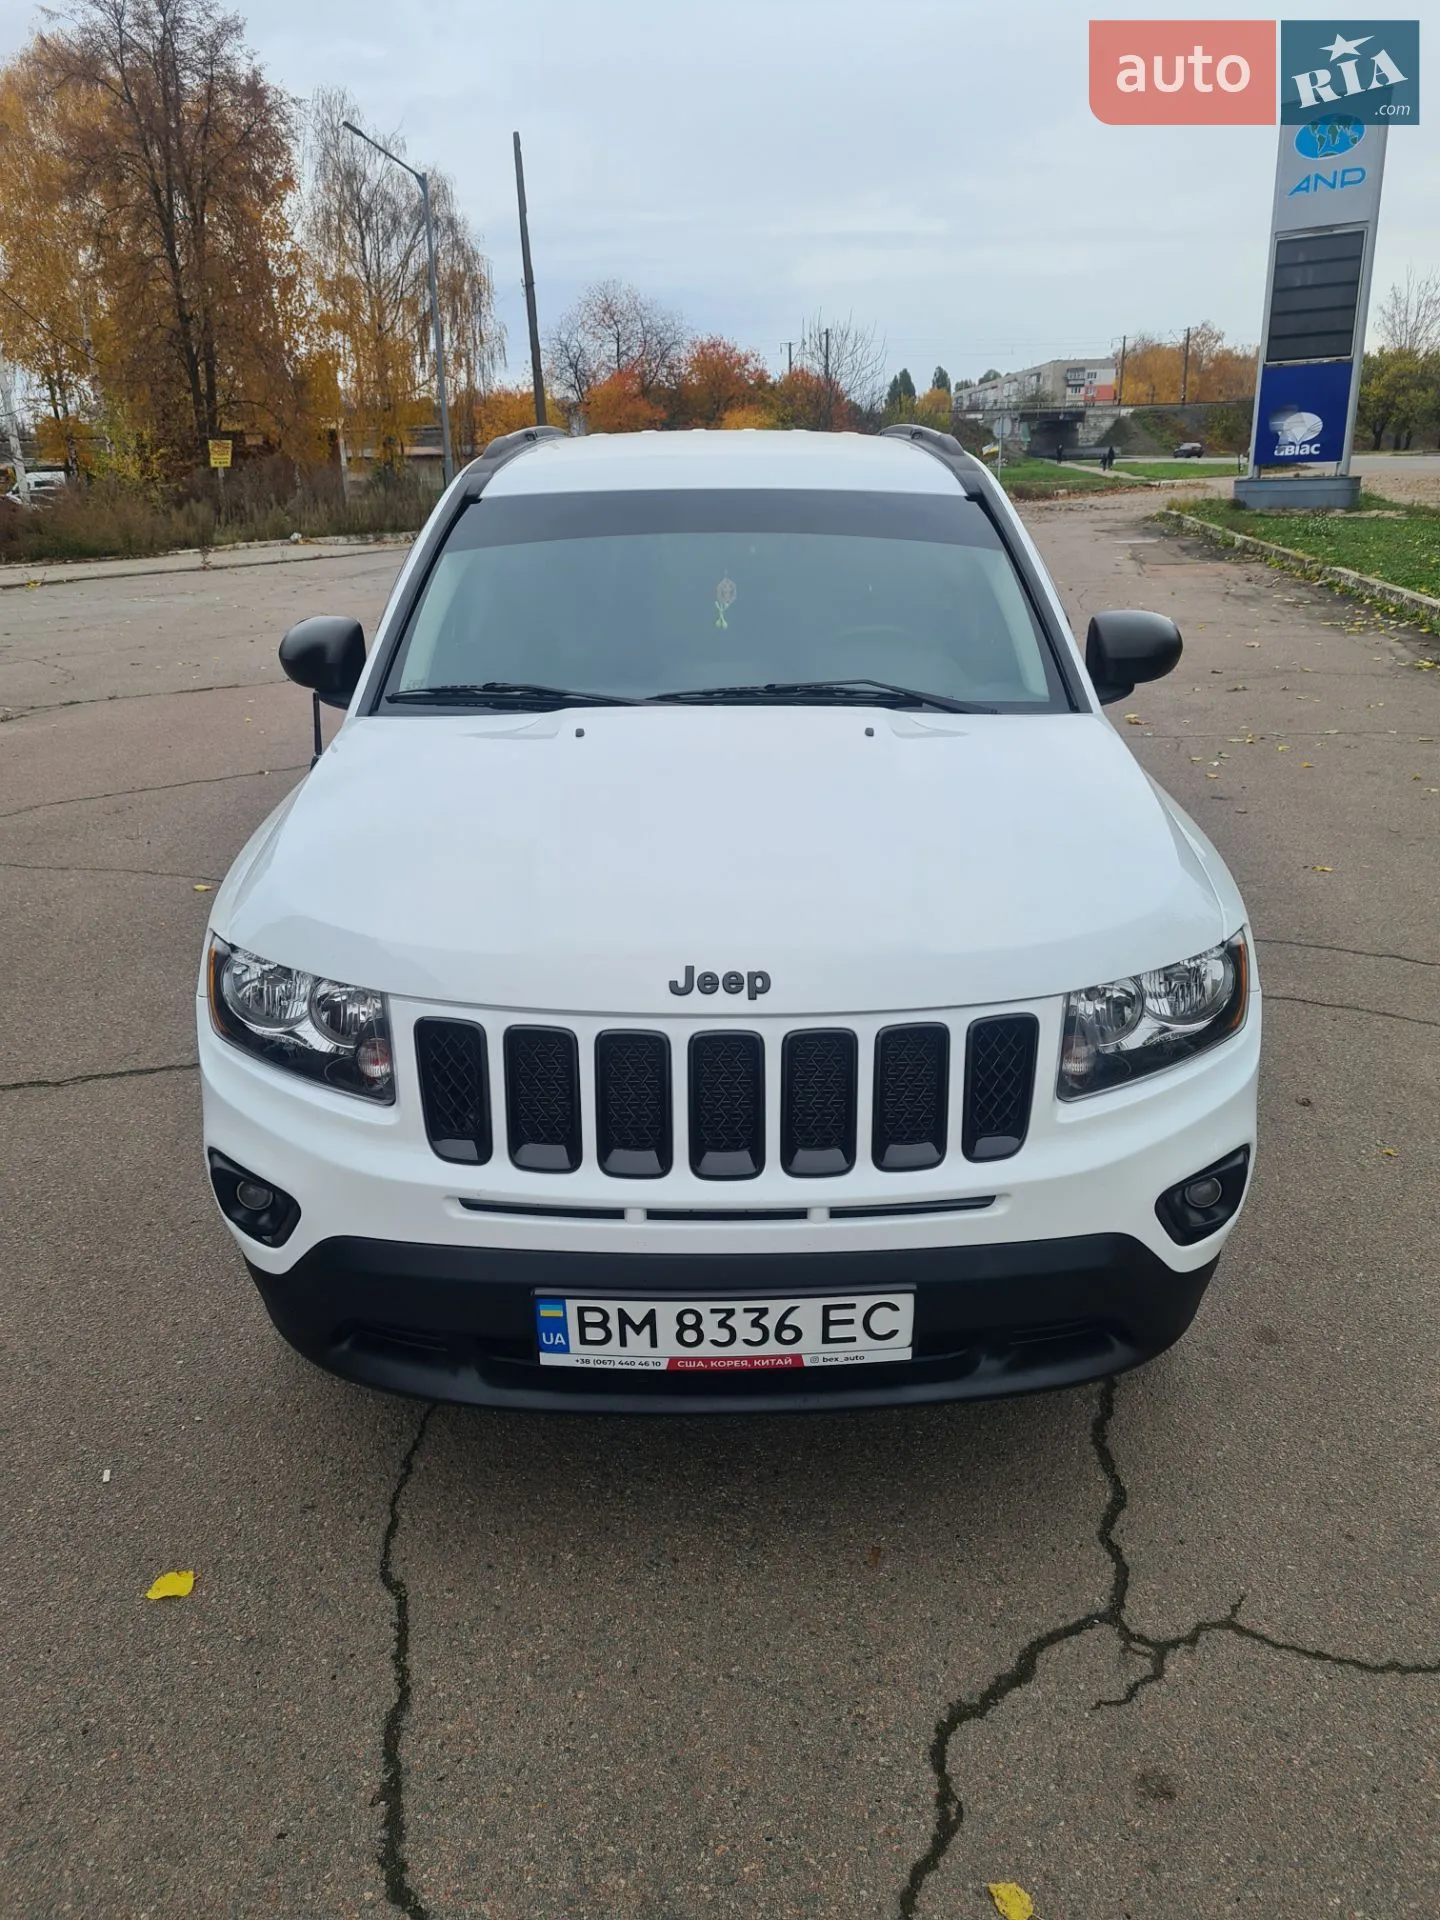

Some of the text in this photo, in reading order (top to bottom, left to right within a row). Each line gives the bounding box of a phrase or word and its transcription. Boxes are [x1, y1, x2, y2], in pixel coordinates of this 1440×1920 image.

[1288, 166, 1367, 197] ANP
[668, 965, 771, 1000] Jeep
[577, 1301, 900, 1348] BM 8336 EC
[542, 1332, 566, 1345] UA
[593, 1358, 615, 1367] (067)
[677, 1356, 792, 1368] США, КОРЕЯ, КИТАЙ
[822, 1354, 865, 1363] bex_auto
